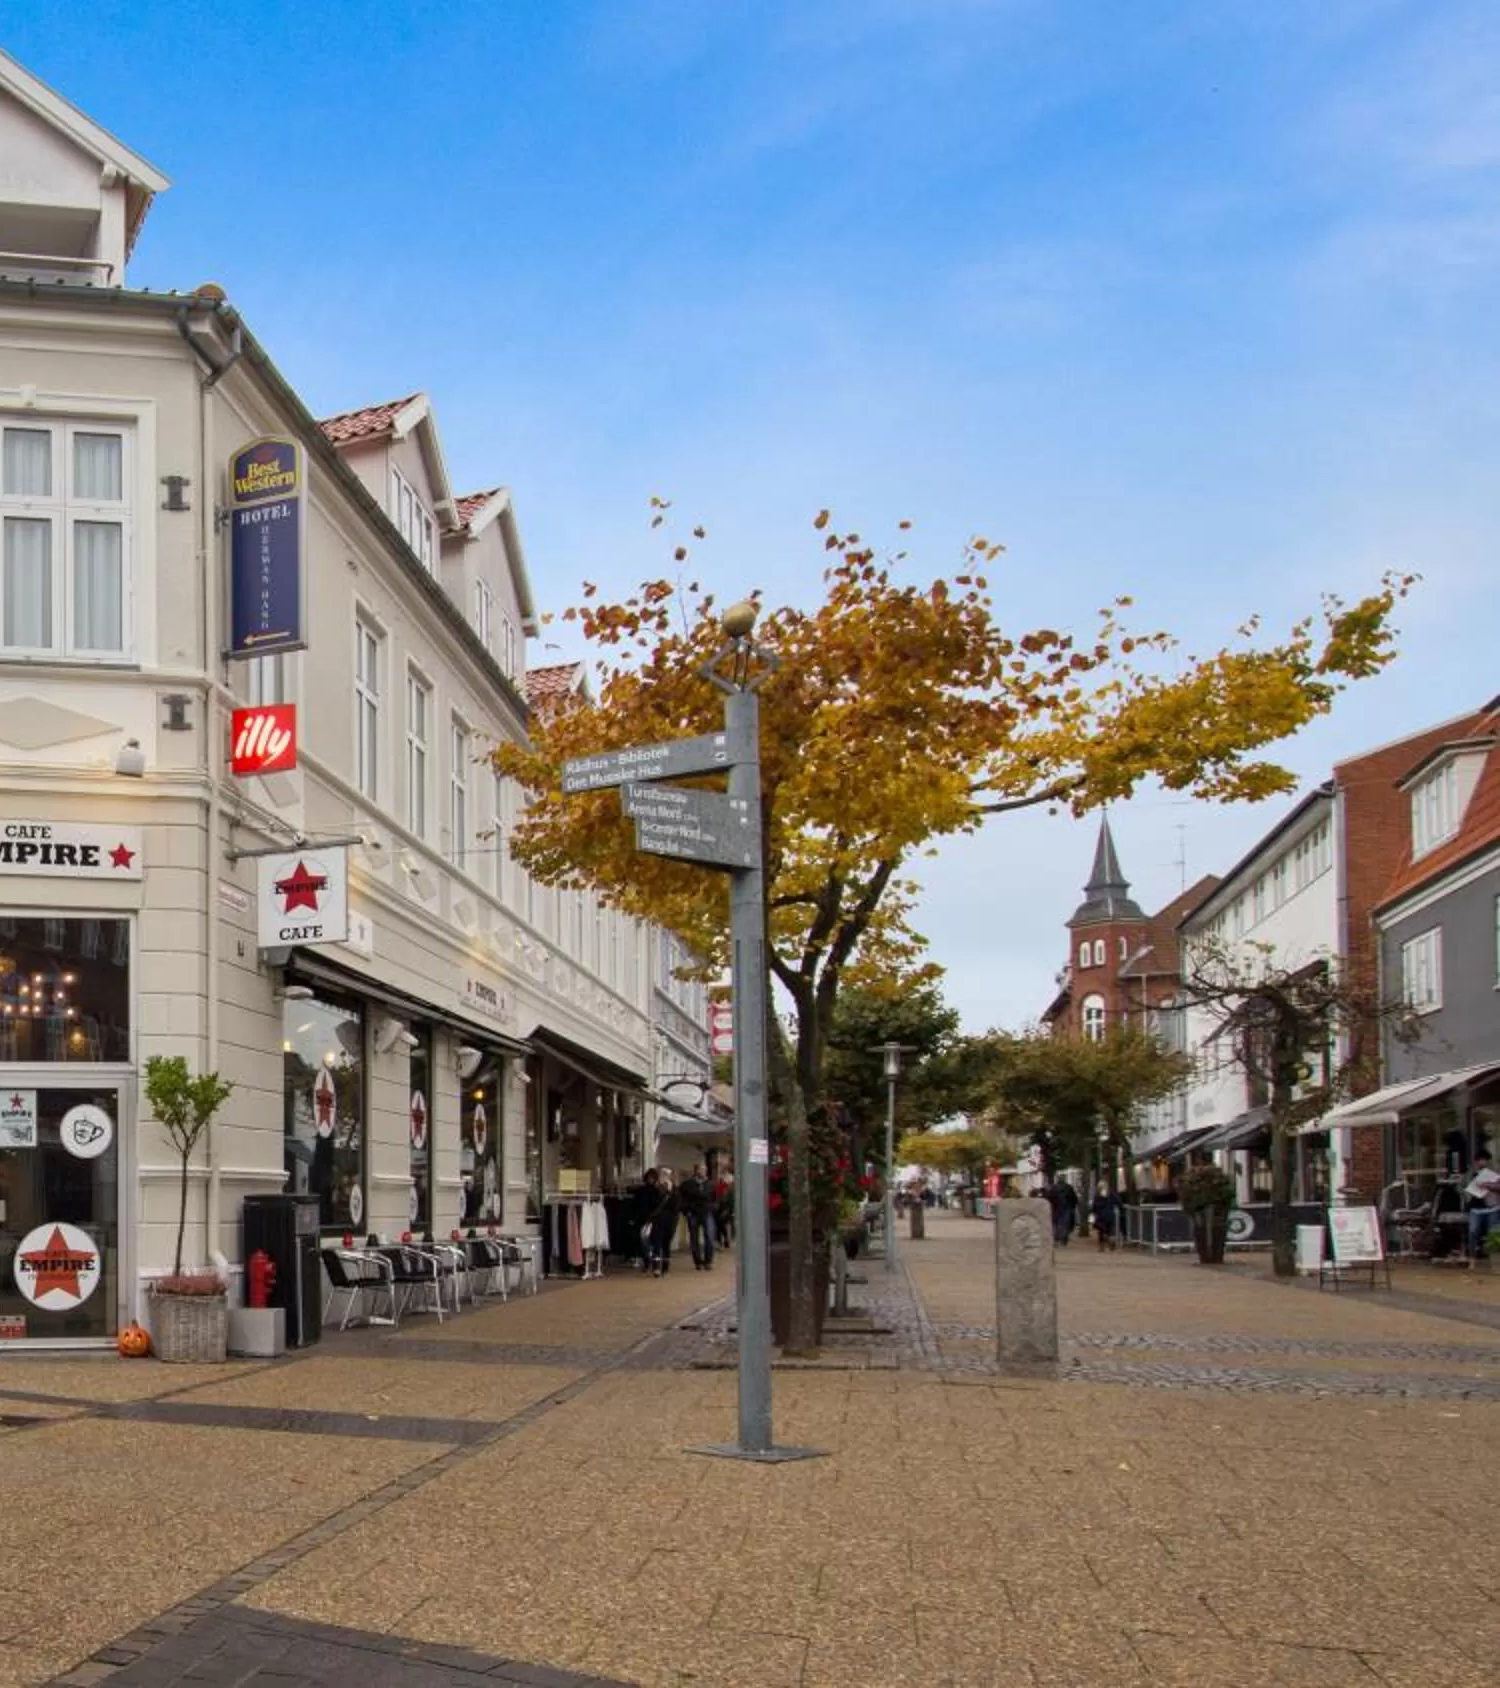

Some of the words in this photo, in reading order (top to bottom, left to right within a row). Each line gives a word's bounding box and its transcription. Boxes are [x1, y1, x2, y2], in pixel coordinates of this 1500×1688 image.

[247, 459, 280, 478] Best
[235, 471, 295, 493] Western
[240, 503, 291, 525] HOTEL
[234, 714, 292, 767] illy
[4, 825, 52, 839] CAFE
[278, 924, 324, 941] CAFE
[19, 1259, 96, 1273] EMPIRE
